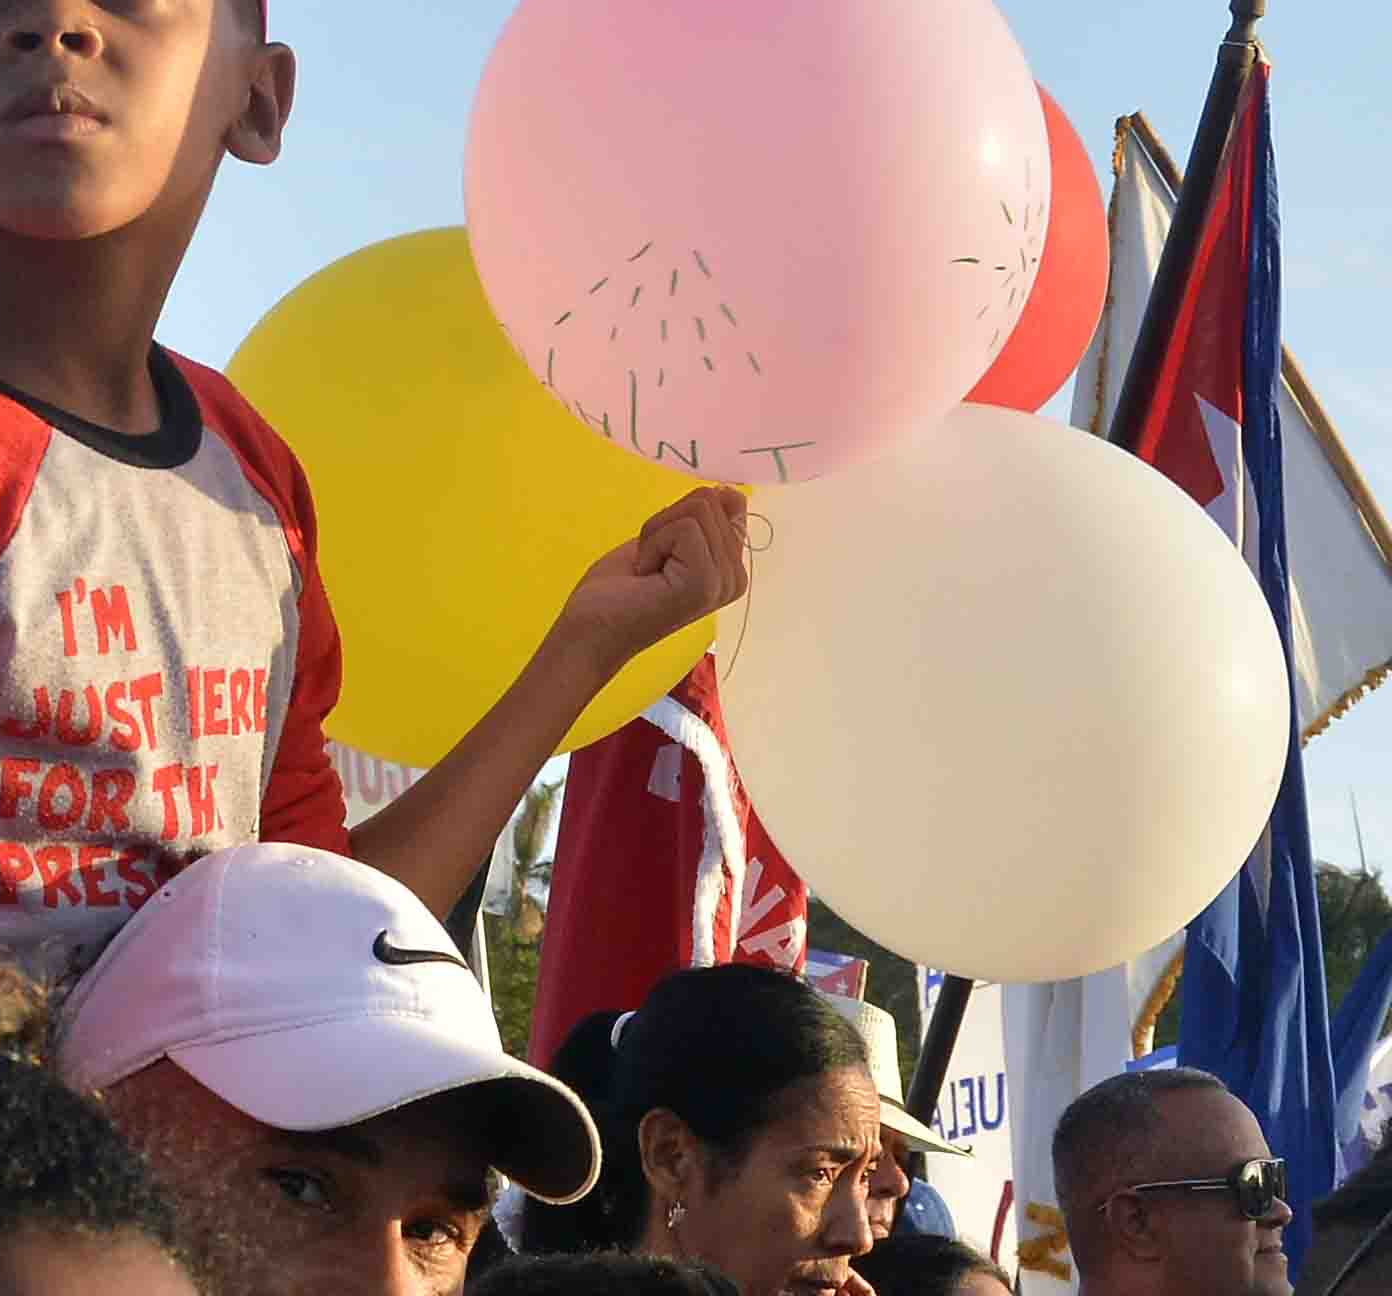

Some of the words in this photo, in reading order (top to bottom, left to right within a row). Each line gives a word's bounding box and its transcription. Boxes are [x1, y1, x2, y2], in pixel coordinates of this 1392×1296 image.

[56, 577, 138, 657] I'M
[0, 672, 163, 752] JUST
[152, 762, 224, 841] TH
